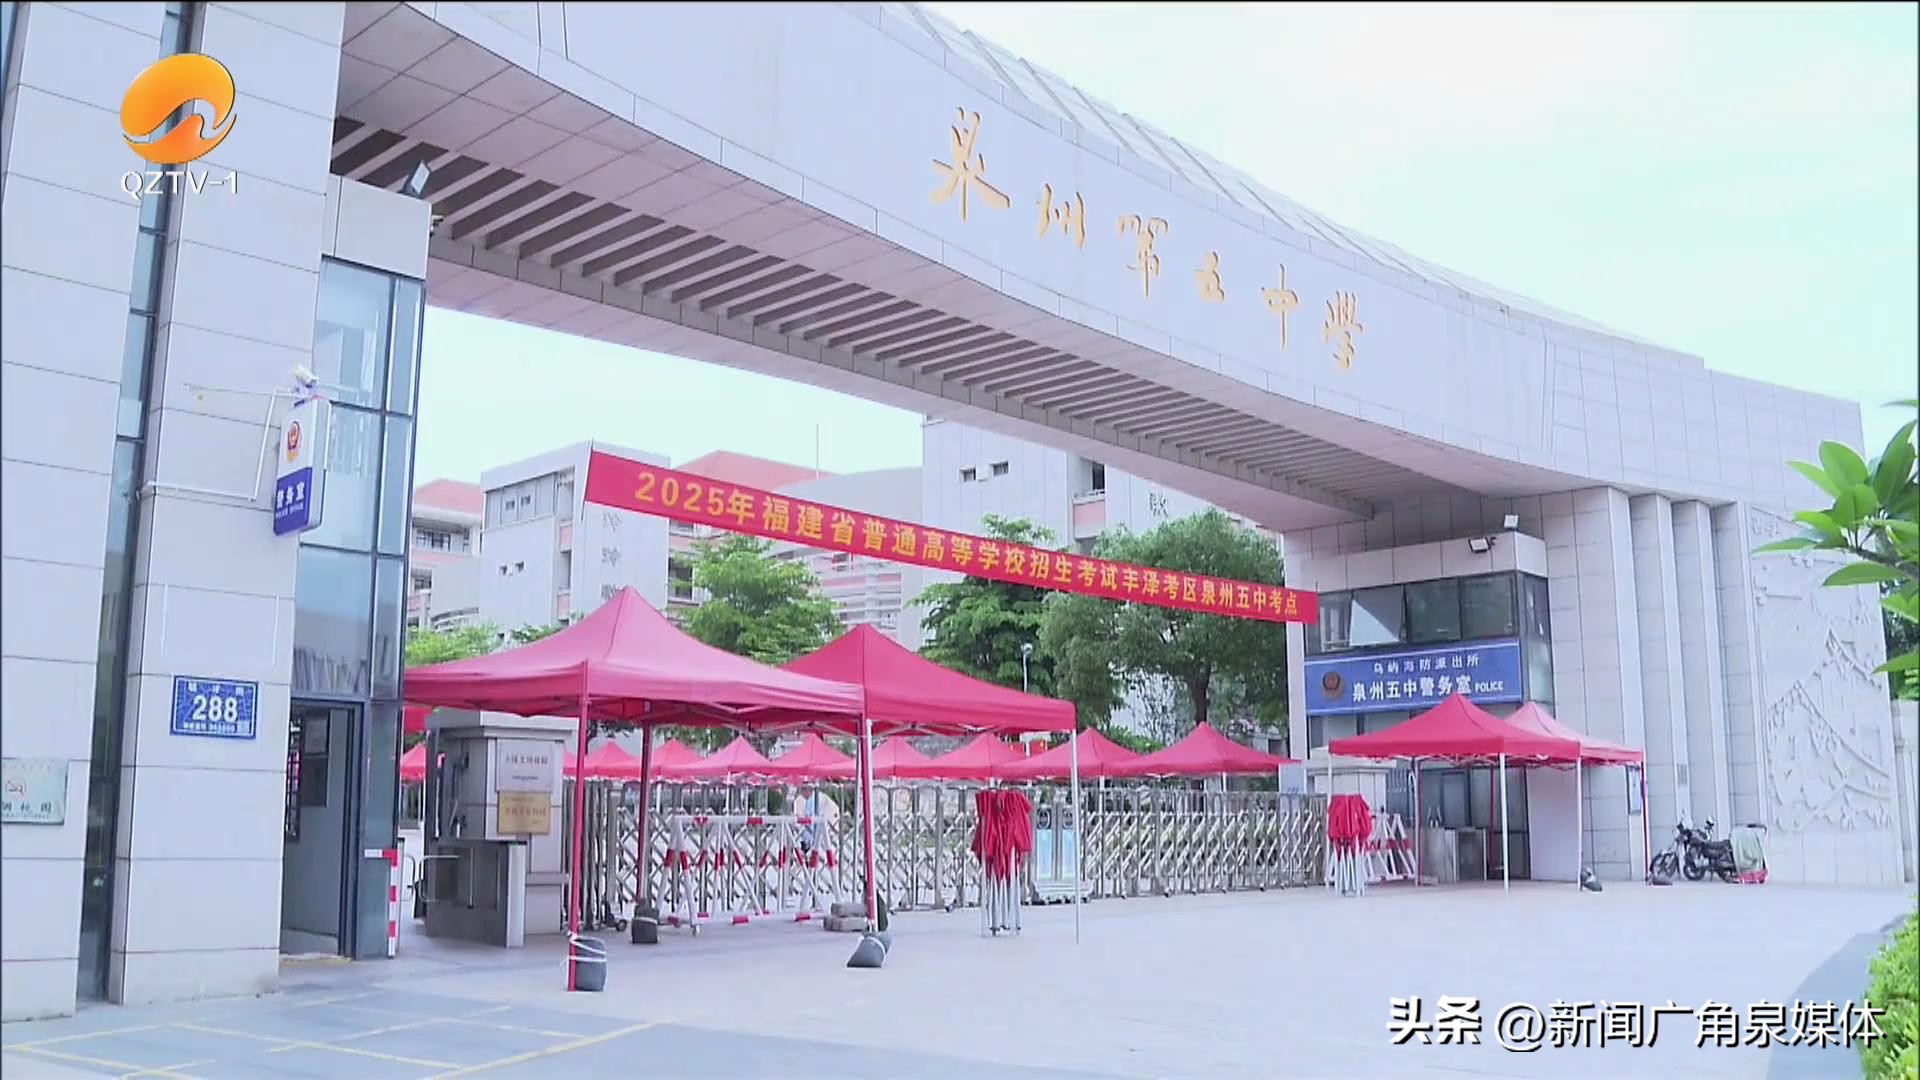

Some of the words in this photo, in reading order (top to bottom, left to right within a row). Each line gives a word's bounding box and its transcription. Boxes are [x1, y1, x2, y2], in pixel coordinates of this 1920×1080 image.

[635, 472, 1298, 616] 2025年福建省普通高等学校招生考试丰泽考区泉州五中考点
[1352, 675, 1472, 702] 泉州五中警务室
[1475, 680, 1504, 694] POLICE
[192, 695, 238, 722] 288
